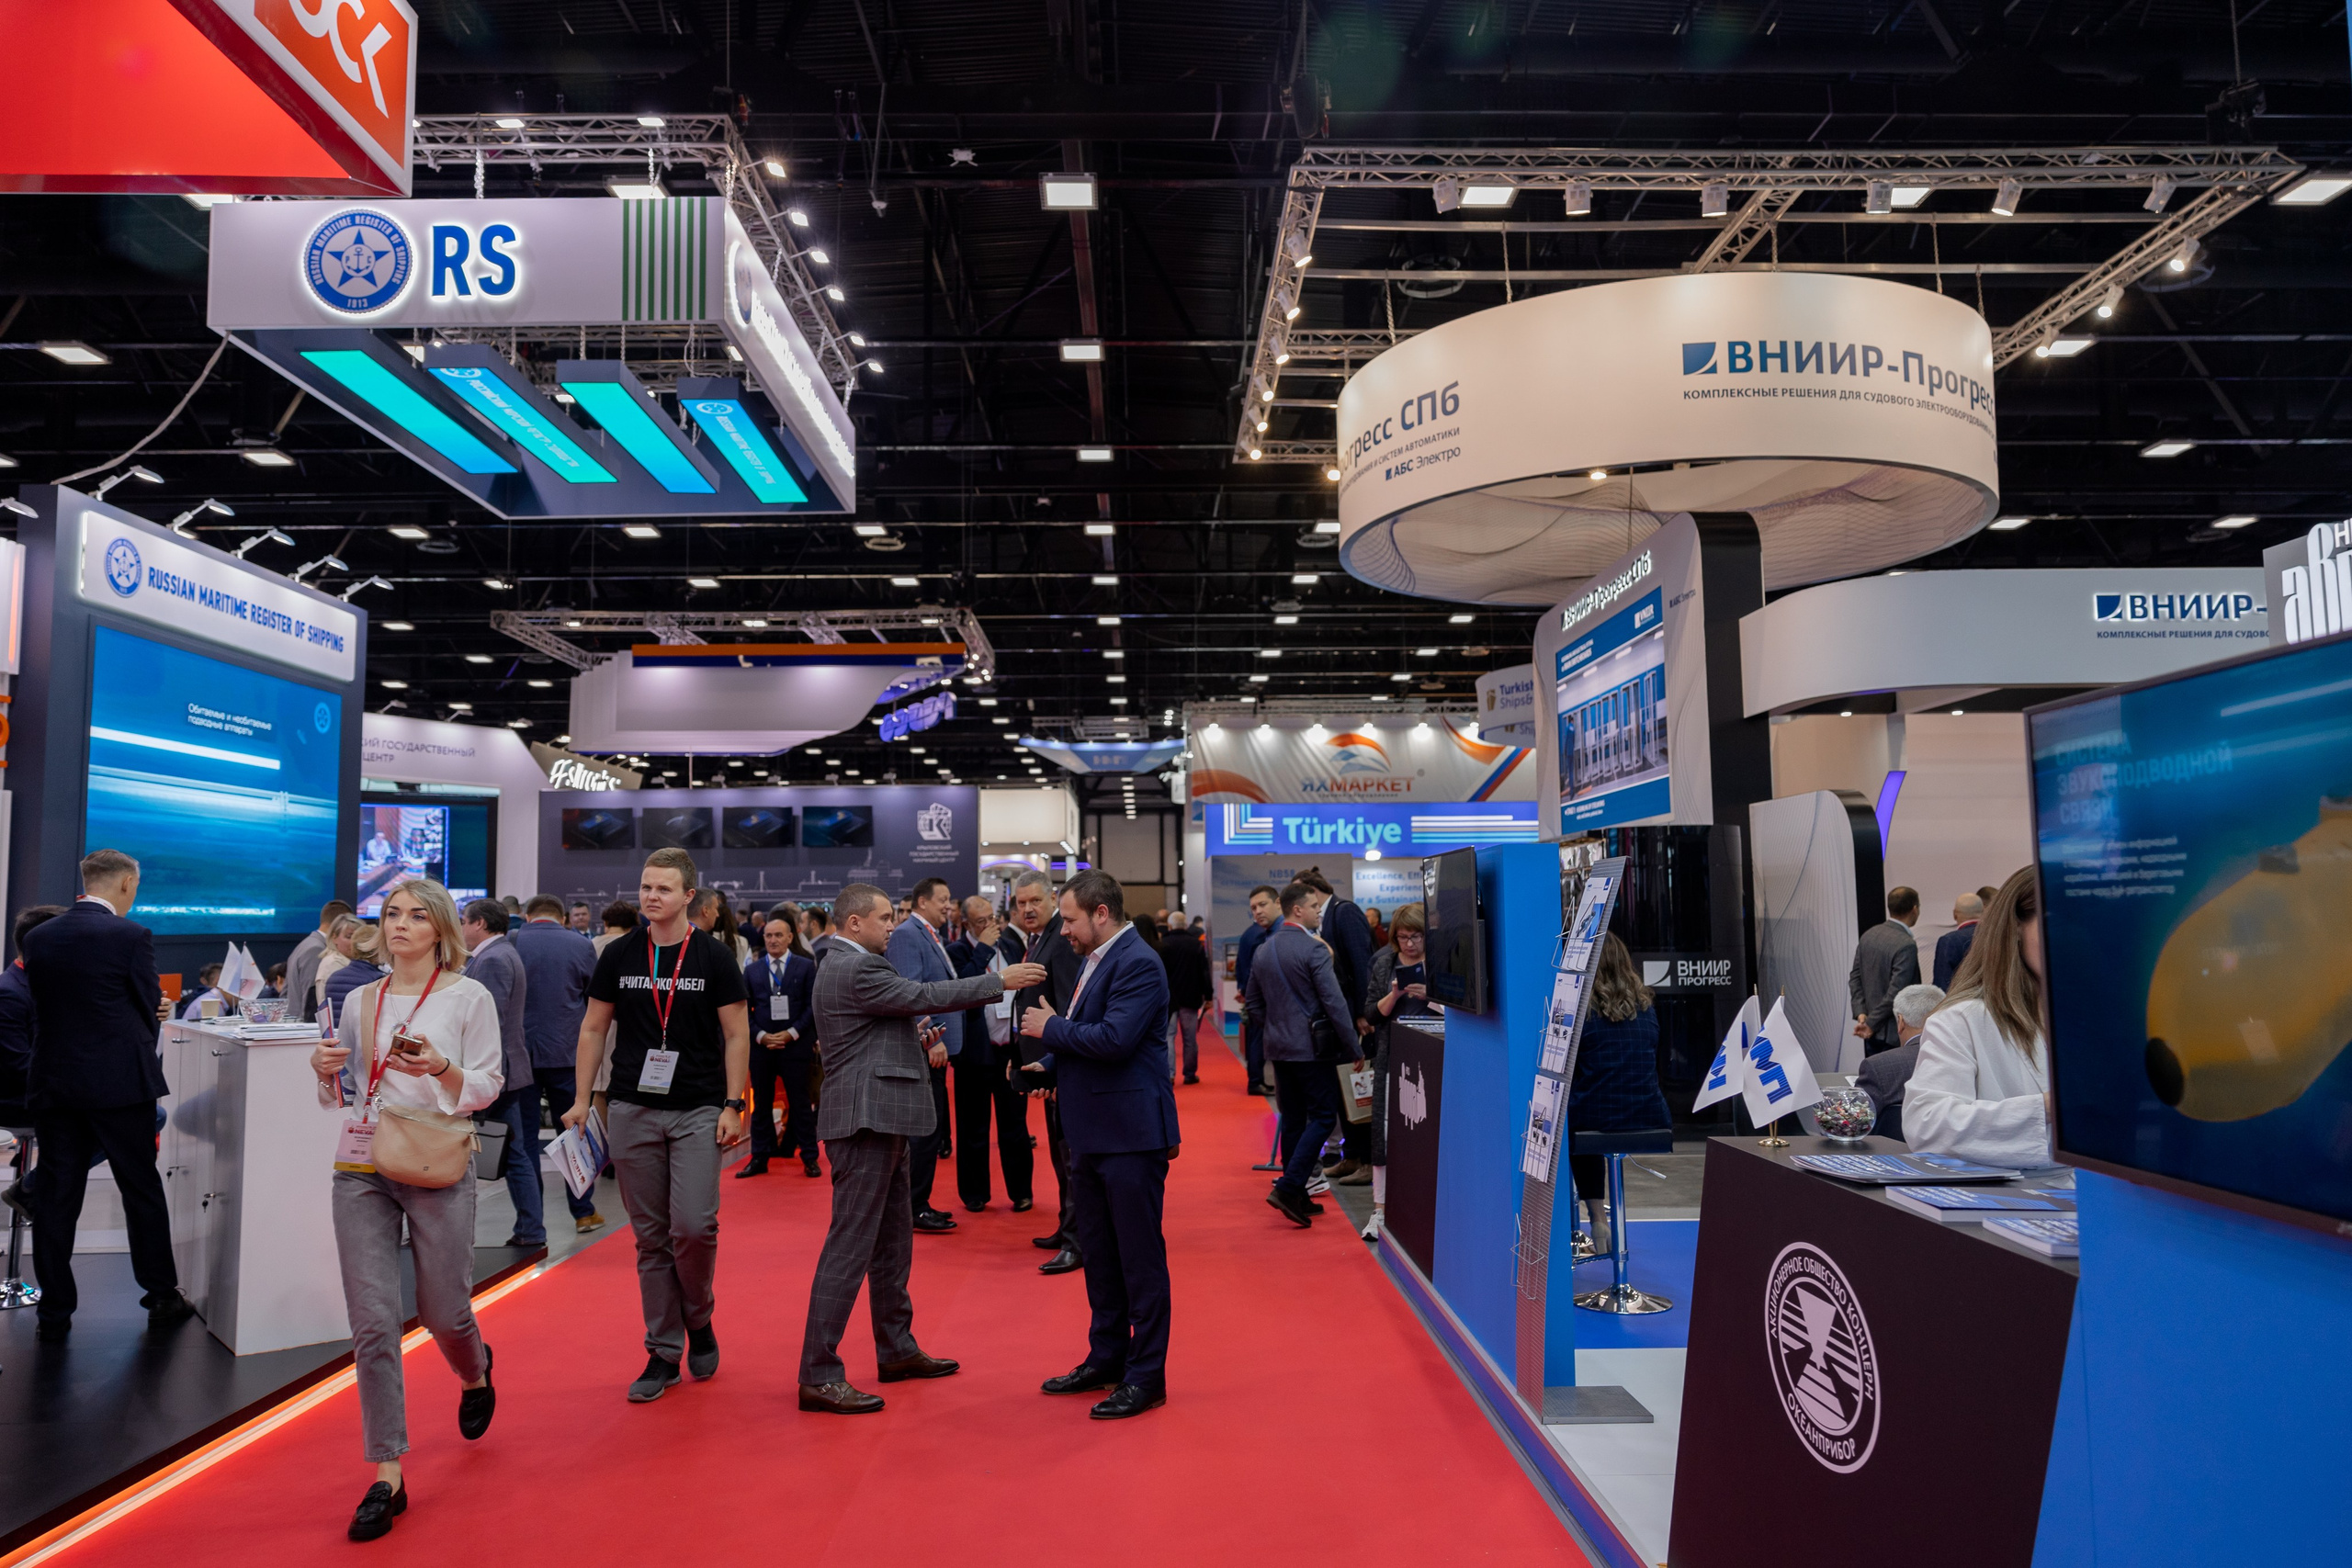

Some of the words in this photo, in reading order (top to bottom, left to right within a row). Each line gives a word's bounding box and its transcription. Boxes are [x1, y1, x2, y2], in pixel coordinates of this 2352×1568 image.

[315, 216, 353, 249] MARITIME
[355, 214, 393, 238] REGISTER
[310, 247, 322, 286] RUSSIAN
[390, 244, 407, 286] SHIPPING
[432, 223, 516, 297] RS
[346, 297, 368, 309] 1913
[1400, 379, 1460, 431] СПб
[1683, 388, 1780, 400] КОМПЛЕКСНЫЕ
[1781, 388, 1838, 399] РЕШЕНИЯ
[1838, 389, 1861, 401] ДЛЯ
[1862, 391, 1916, 408] СУДОВОГО
[1404, 426, 1460, 454] АВТОМАТИКИ
[1393, 458, 1414, 478] АБС
[1415, 446, 1462, 469] Электро
[148, 566, 196, 603] RUSSIAN
[198, 586, 248, 620] MARITIME
[250, 604, 292, 636] REGISTER
[294, 619, 305, 639] OF
[307, 625, 345, 653] SHIPPING
[2129, 593, 2267, 620] ВНИИР-
[2097, 629, 2166, 638] КОМПЛЕКСНЫЕ
[2168, 630, 2212, 638] РЕШЕНИЯ
[2214, 630, 2233, 639] ДЛЯ
[187, 703, 226, 720] Обитаемые
[232, 714, 273, 731] необитаемые
[187, 715, 223, 730] подводные
[224, 721, 254, 737] аппараты
[381, 739, 476, 758] ГОСУДАРСТВЕННЫЙ
[1282, 816, 1403, 851] Türkiye
[1677, 960, 1731, 976] ВНИИР
[1678, 976, 1732, 987] ПРОГРЕСС
[1769, 1256, 1804, 1339] АКЦИОНЕРНОЕ
[1803, 1257, 1847, 1305] ОБЩЕСТВО
[1846, 1302, 1874, 1401] КОНЦЕРН
[1787, 1393, 1856, 1461] ОКЕАНПРИБОР
